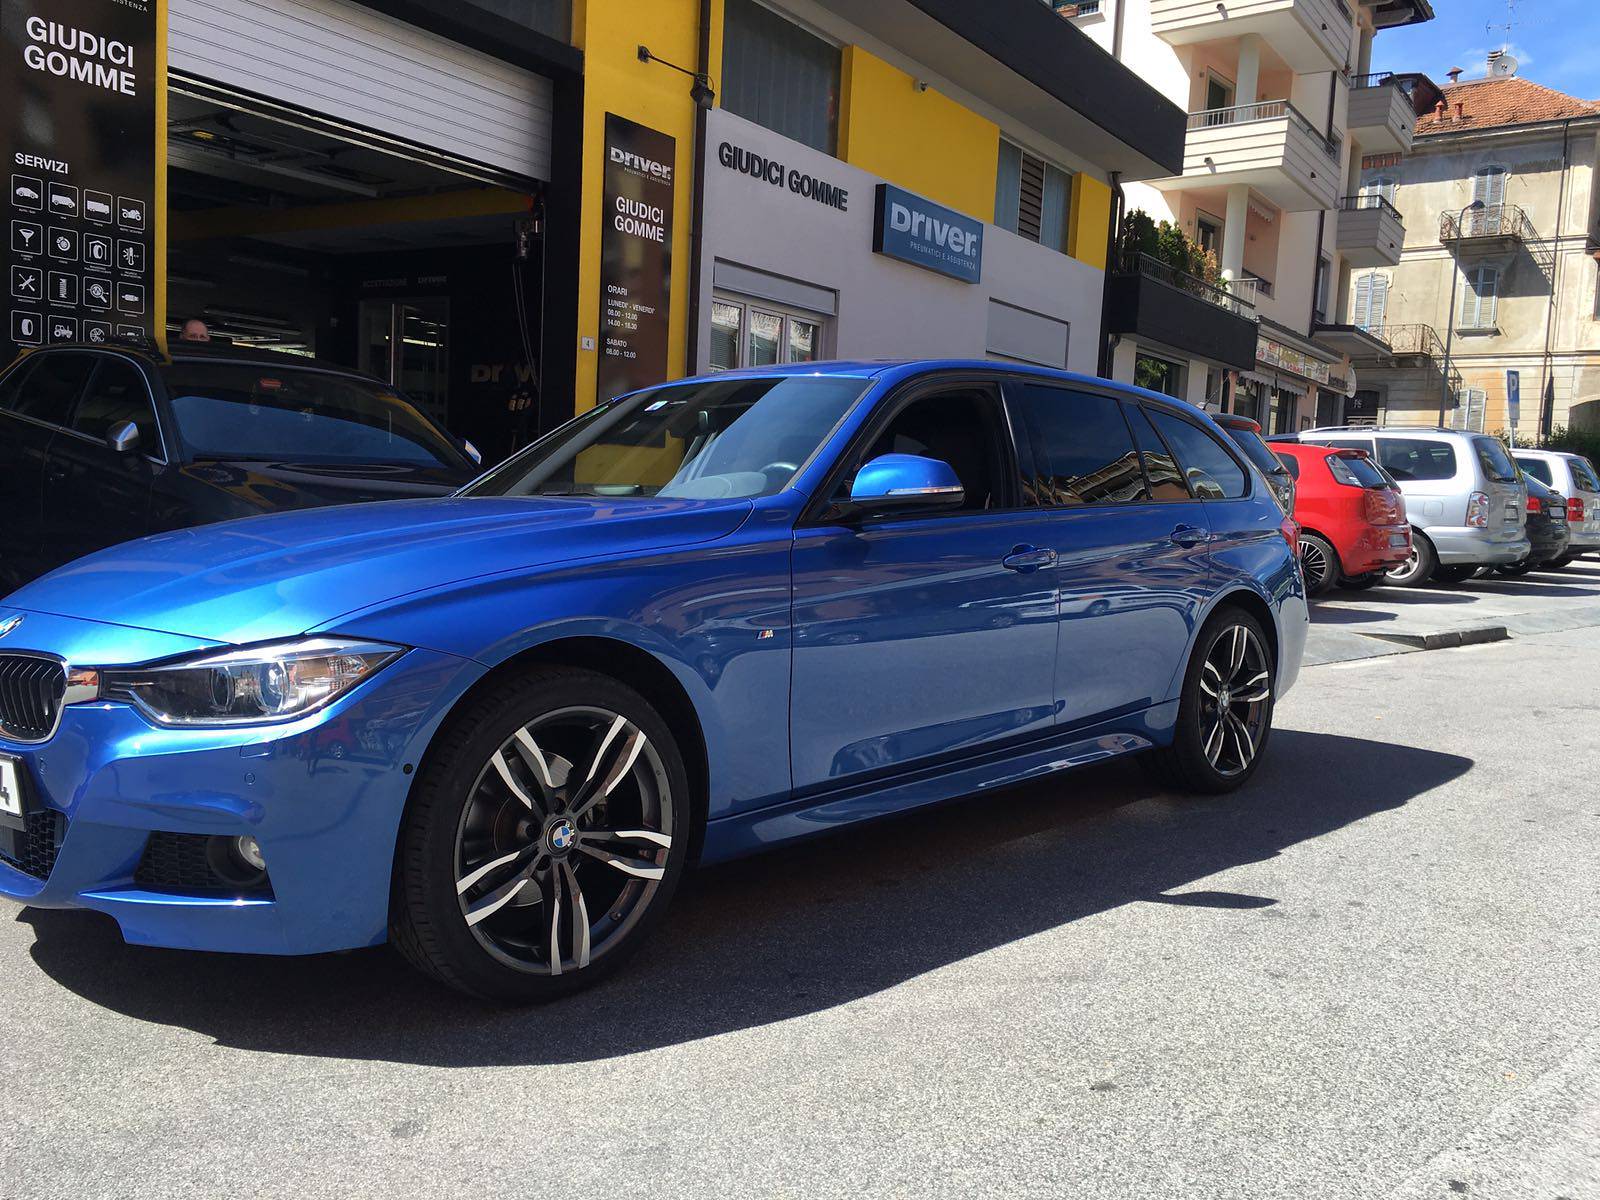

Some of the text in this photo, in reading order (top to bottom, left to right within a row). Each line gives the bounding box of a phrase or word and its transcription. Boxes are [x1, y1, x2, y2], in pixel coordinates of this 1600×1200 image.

[26, 16, 134, 68] GIUDICI
[24, 45, 136, 96] GOMME
[14, 152, 69, 174] SERVIZI
[718, 141, 848, 212] GIUDICI GOMME
[616, 196, 664, 224] GIUDICI
[614, 215, 664, 242] GOMME
[910, 241, 941, 258] PNEUMATICI
[946, 255, 976, 272] ASSISTENZA
[608, 284, 628, 296] ORARI
[606, 338, 627, 348] SABATO
[1510, 374, 1518, 399] P
